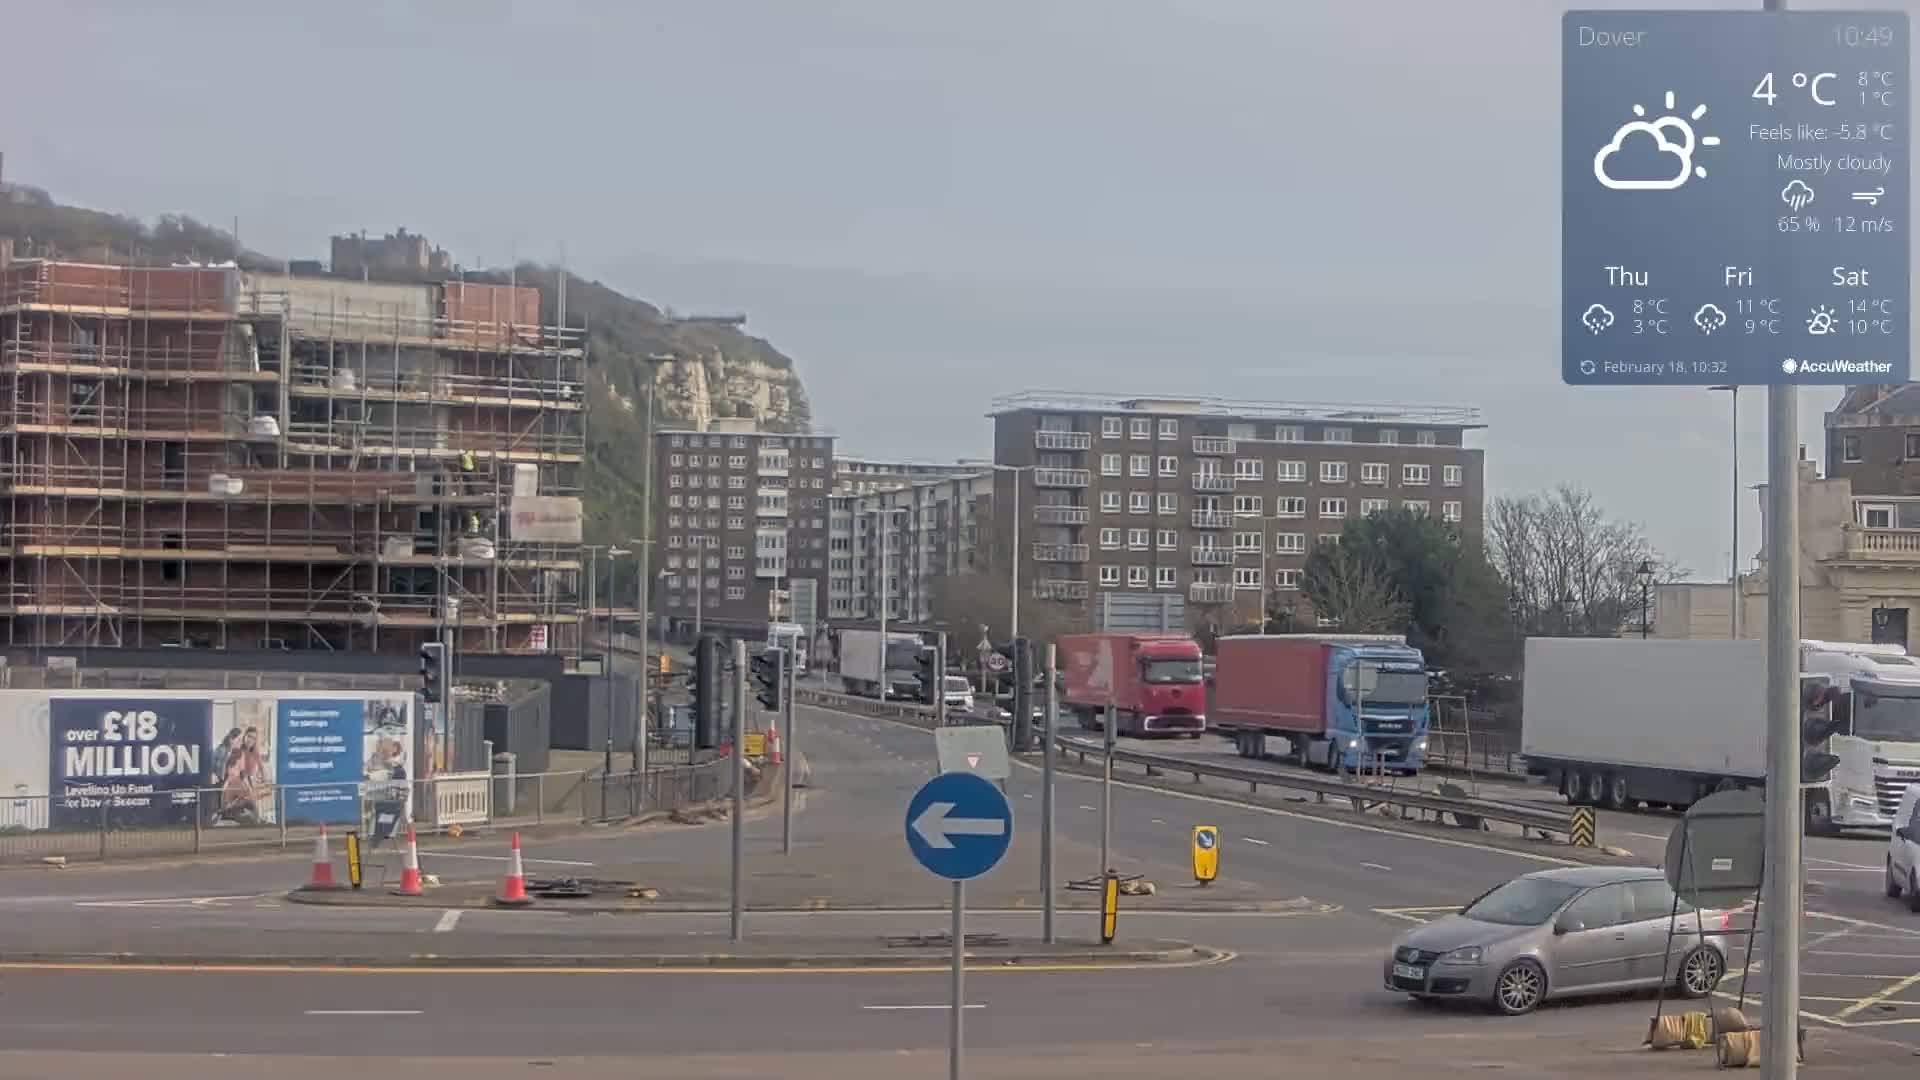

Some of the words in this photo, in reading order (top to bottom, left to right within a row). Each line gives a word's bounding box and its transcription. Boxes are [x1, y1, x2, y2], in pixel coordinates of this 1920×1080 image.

[66, 728, 99, 741] over
[103, 710, 158, 741] £18
[65, 744, 200, 777] MILLION
[128, 783, 154, 795] Fund
